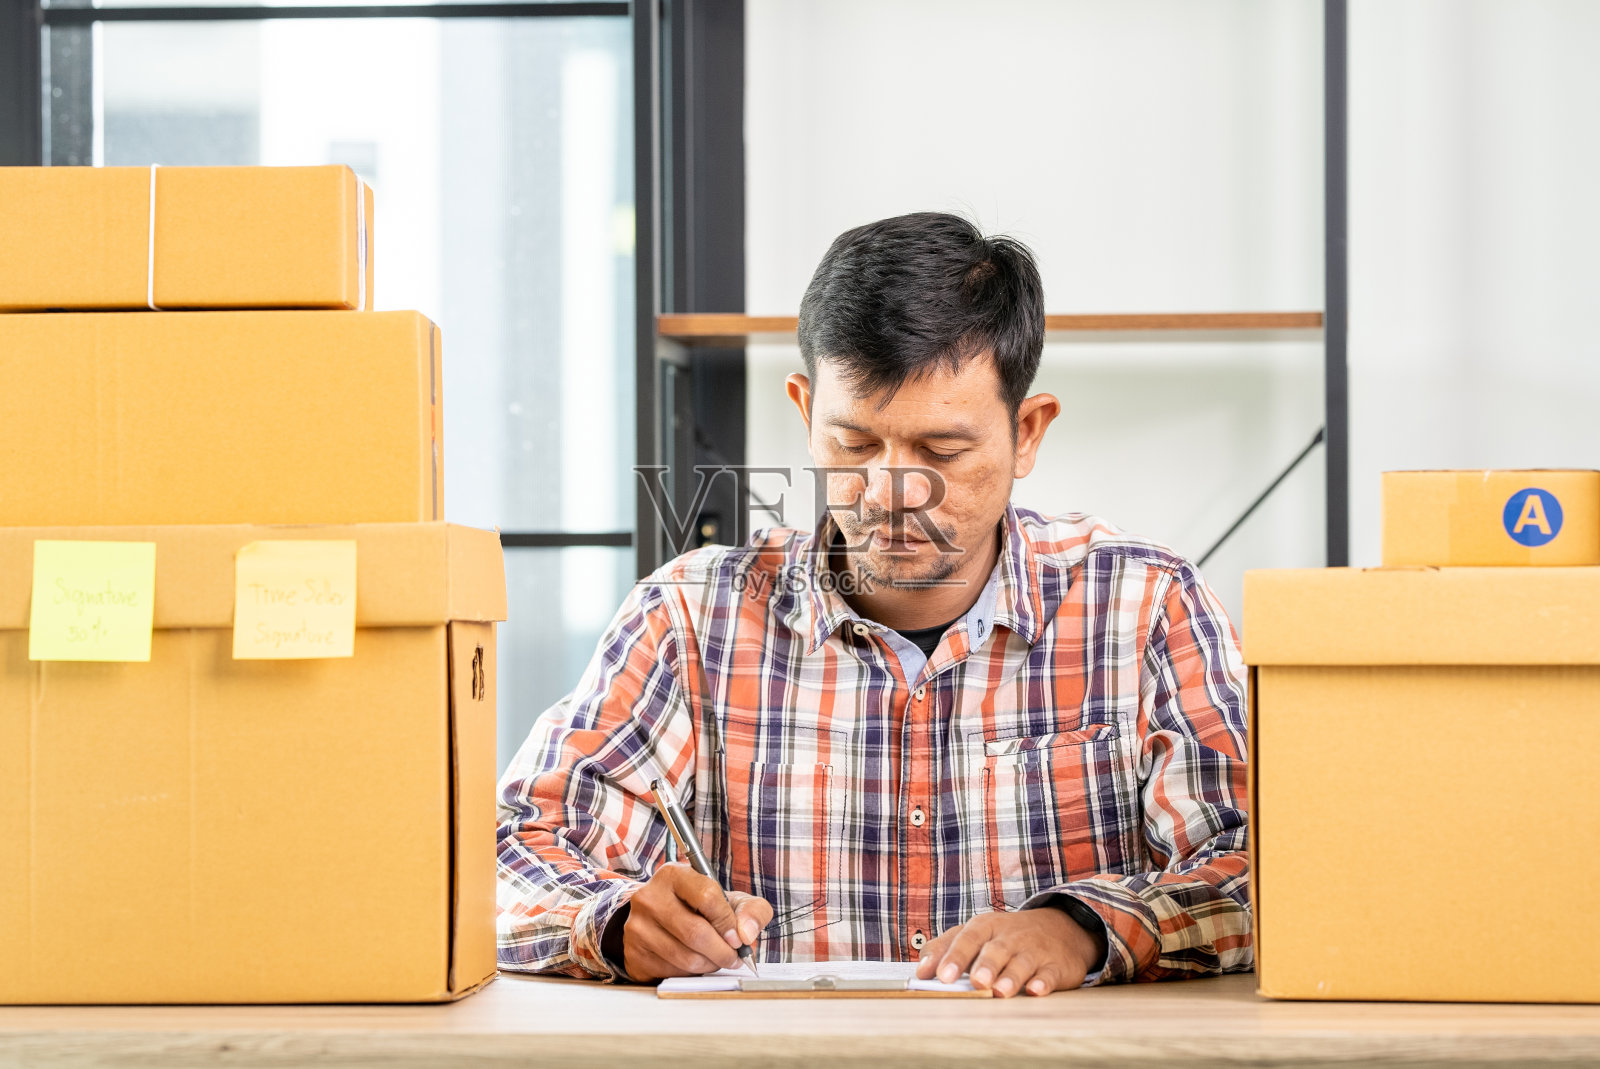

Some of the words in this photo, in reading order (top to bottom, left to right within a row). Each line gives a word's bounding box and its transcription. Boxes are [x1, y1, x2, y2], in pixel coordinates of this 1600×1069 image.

[1513, 495, 1552, 535] A
[53, 576, 139, 616] Signature
[254, 618, 336, 649] Signature
